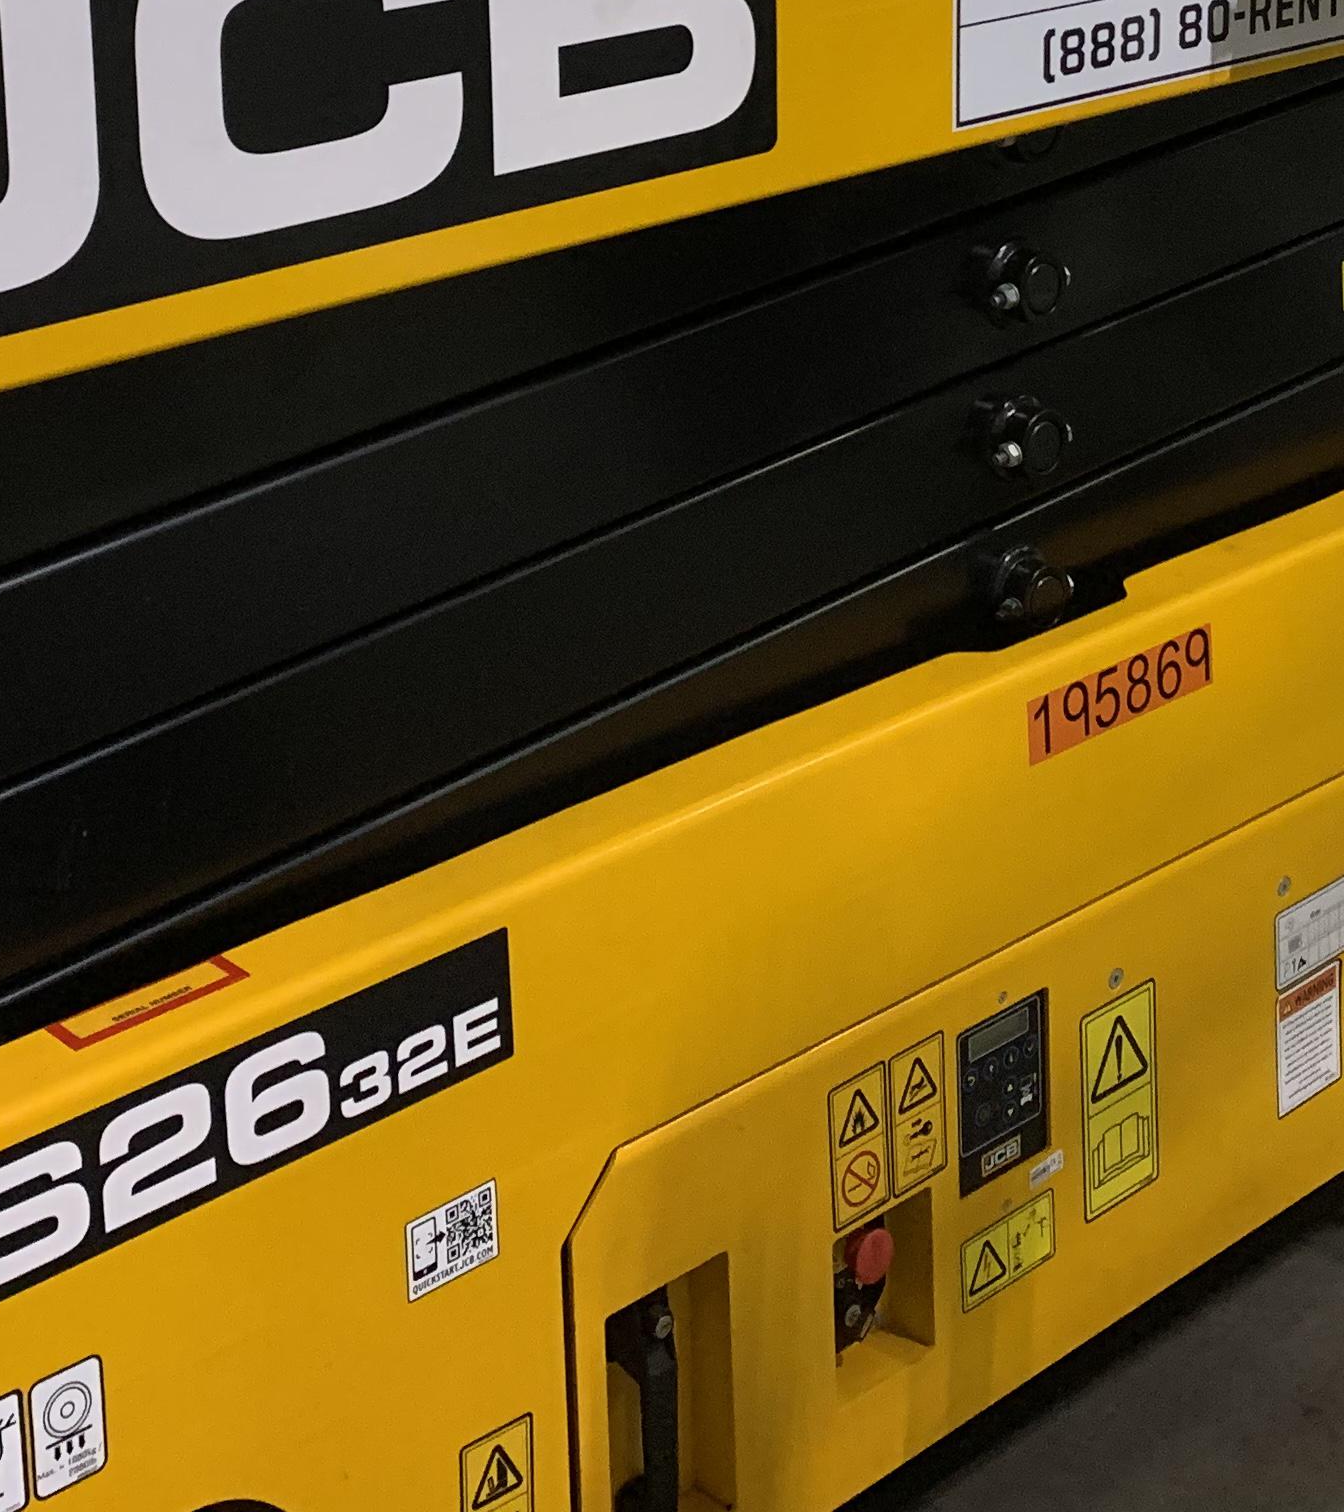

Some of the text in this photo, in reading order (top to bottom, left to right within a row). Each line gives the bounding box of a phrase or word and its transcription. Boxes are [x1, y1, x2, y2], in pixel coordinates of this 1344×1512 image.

[1043, 7, 1161, 83] (888)
[1033, 628, 1211, 756] 195869
[984, 1140, 1019, 1171] JCB
[412, 1244, 494, 1296] QUICKSTART.JCB.COM
